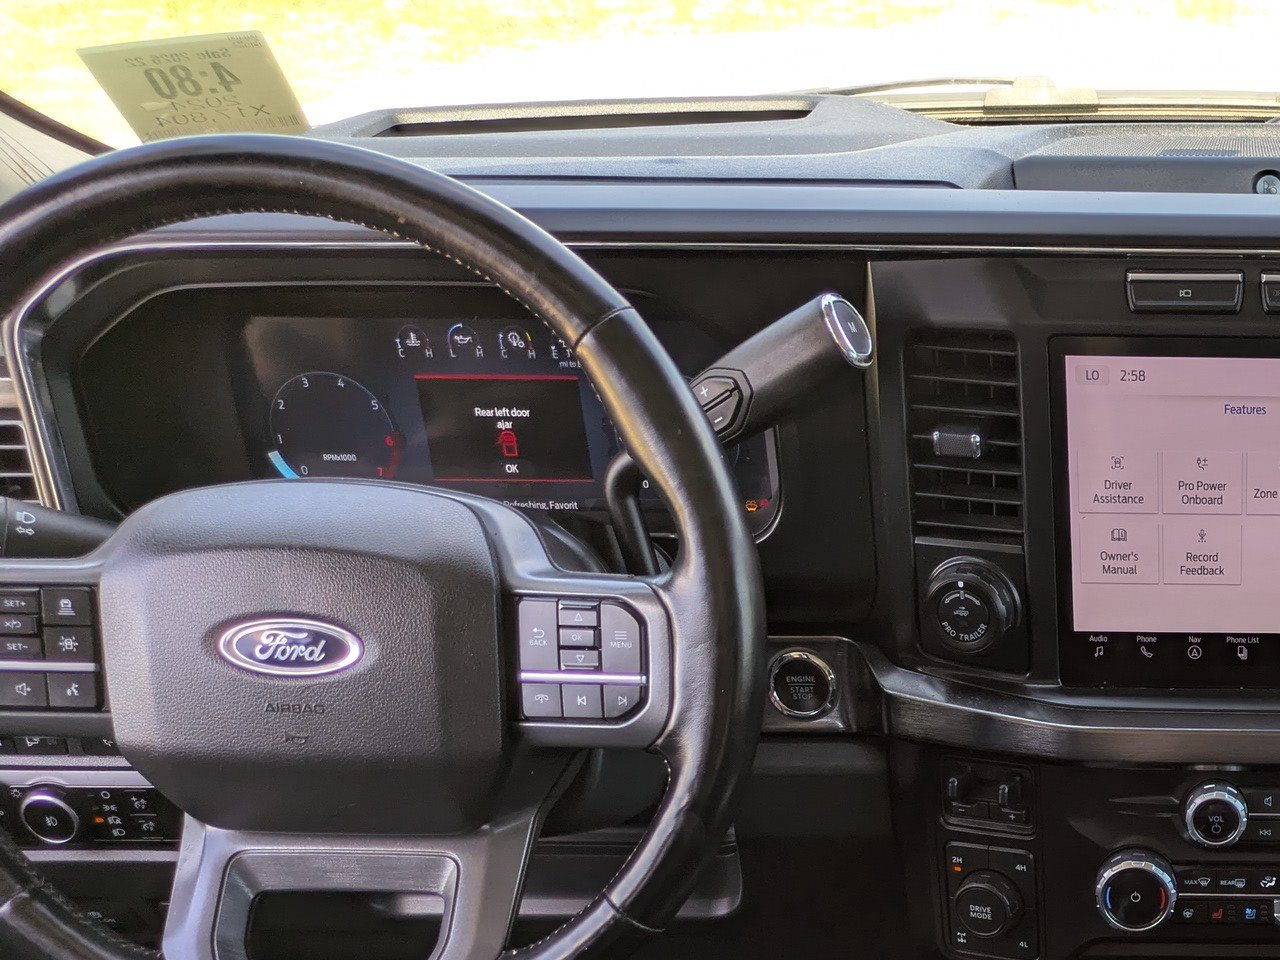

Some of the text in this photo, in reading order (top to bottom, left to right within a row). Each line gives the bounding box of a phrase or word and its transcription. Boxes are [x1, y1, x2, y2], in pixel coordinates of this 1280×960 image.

[1085, 370, 1100, 381] LO
[1120, 370, 1146, 381] 2:58
[302, 378, 309, 388] 3
[338, 378, 345, 388] 4
[278, 400, 285, 410] 2
[371, 400, 379, 410] 5
[1224, 404, 1267, 415] Features
[475, 407, 530, 417] Rear left door
[497, 420, 513, 431] ajar
[322, 453, 357, 462] RPMx1000
[300, 465, 309, 475] 0
[505, 464, 519, 473] OK
[1104, 479, 1132, 490] Driver
[1178, 480, 1227, 491] Pro Power
[1093, 493, 1144, 504] Assistance
[1253, 488, 1278, 499] Zone
[1181, 494, 1223, 505] Onboard
[549, 500, 579, 510] Favorit
[1100, 551, 1139, 561] Owner's
[1186, 552, 1219, 562] Record
[1102, 565, 1137, 575] Manual
[1180, 565, 1225, 576] Feedback
[941, 621, 988, 641] PRO TRAILER
[529, 638, 548, 647] BACK
[1089, 635, 1108, 643] Audio
[1136, 635, 1157, 643] Phone
[1226, 636, 1260, 644] Phone List
[255, 630, 326, 662] Ford
[610, 640, 632, 649] MENU
[786, 675, 816, 683] ENGINE
[790, 686, 814, 694] START
[264, 702, 326, 715] AIRBAG
[1208, 815, 1224, 823] VOL
[1015, 864, 1026, 872] 4H
[970, 904, 992, 914] DRIVE
[970, 911, 992, 921] MODE
